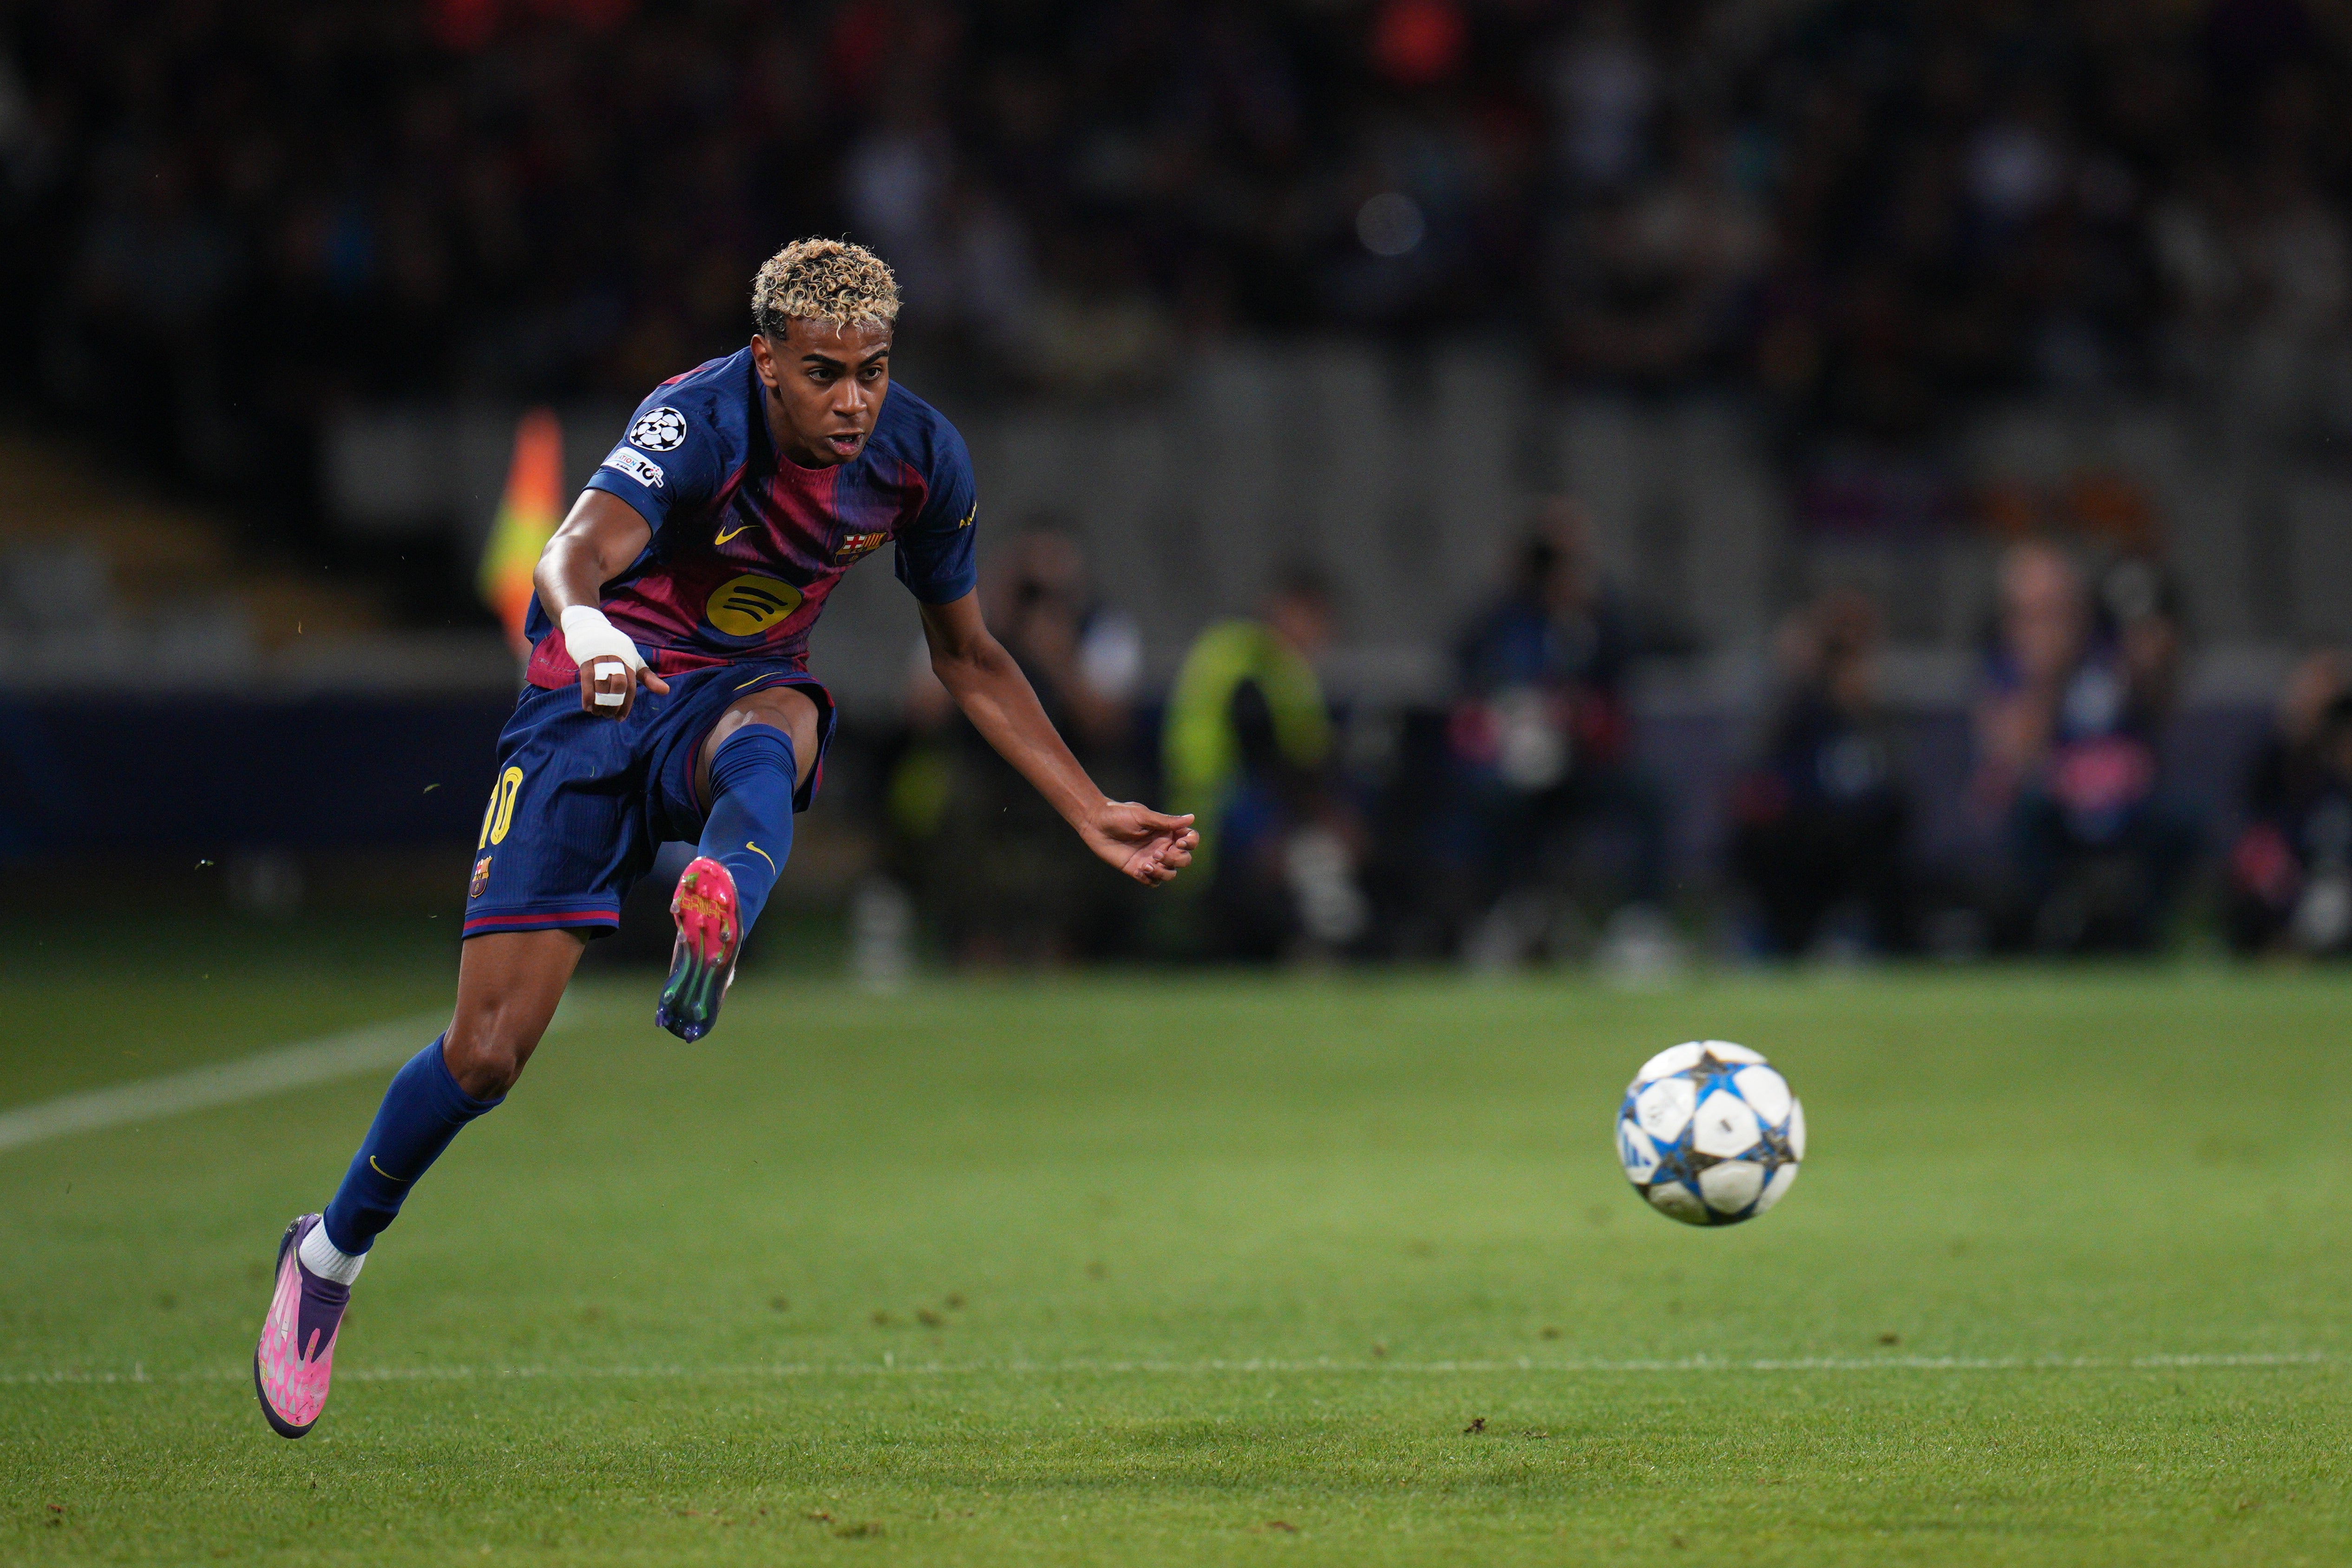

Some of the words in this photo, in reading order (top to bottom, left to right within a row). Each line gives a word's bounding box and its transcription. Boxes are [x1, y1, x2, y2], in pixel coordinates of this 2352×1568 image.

[646, 419, 669, 435] 5
[636, 461, 655, 480] 10
[478, 767, 524, 850] 10
